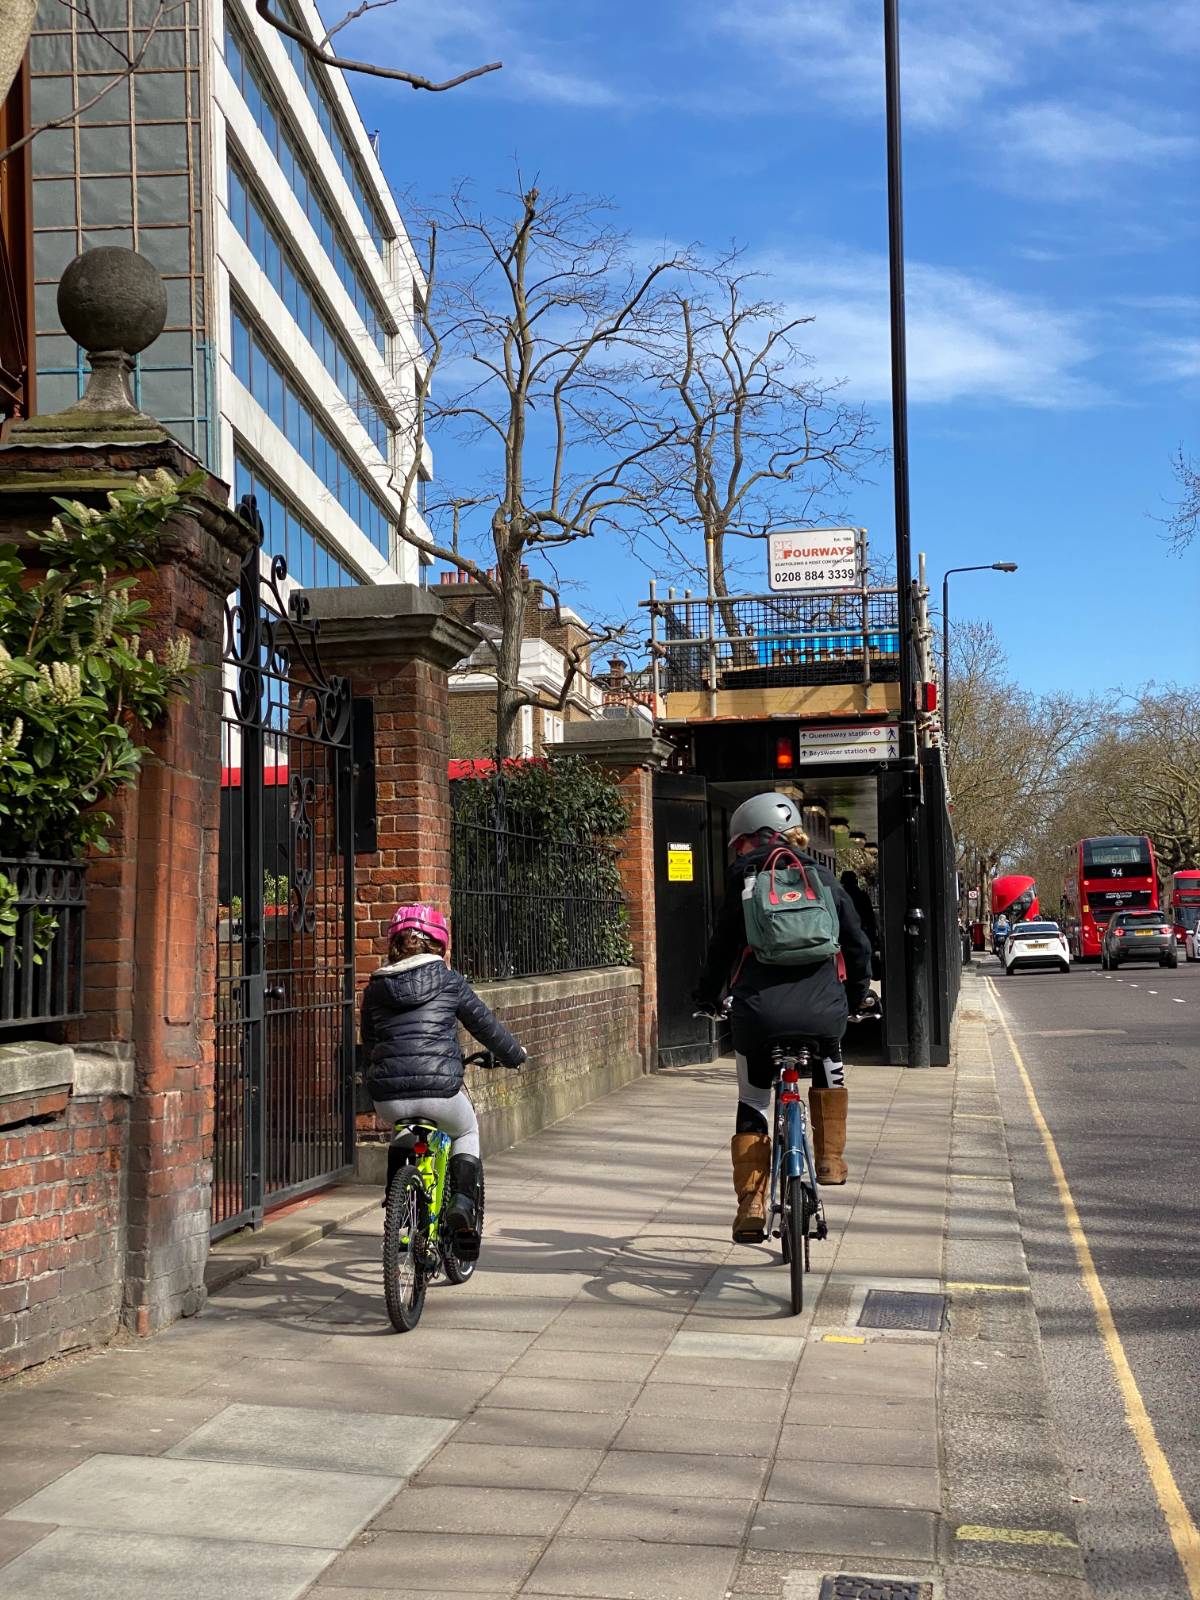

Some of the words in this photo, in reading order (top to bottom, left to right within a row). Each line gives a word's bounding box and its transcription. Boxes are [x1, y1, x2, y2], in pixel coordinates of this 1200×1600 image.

[783, 546, 854, 560] FOURWAYS
[775, 571, 802, 582] 0208
[804, 570, 825, 581] 884
[828, 568, 855, 580] 3339
[808, 731, 847, 739] Queensway
[809, 749, 842, 757] Bayswater
[1111, 868, 1123, 877] 94
